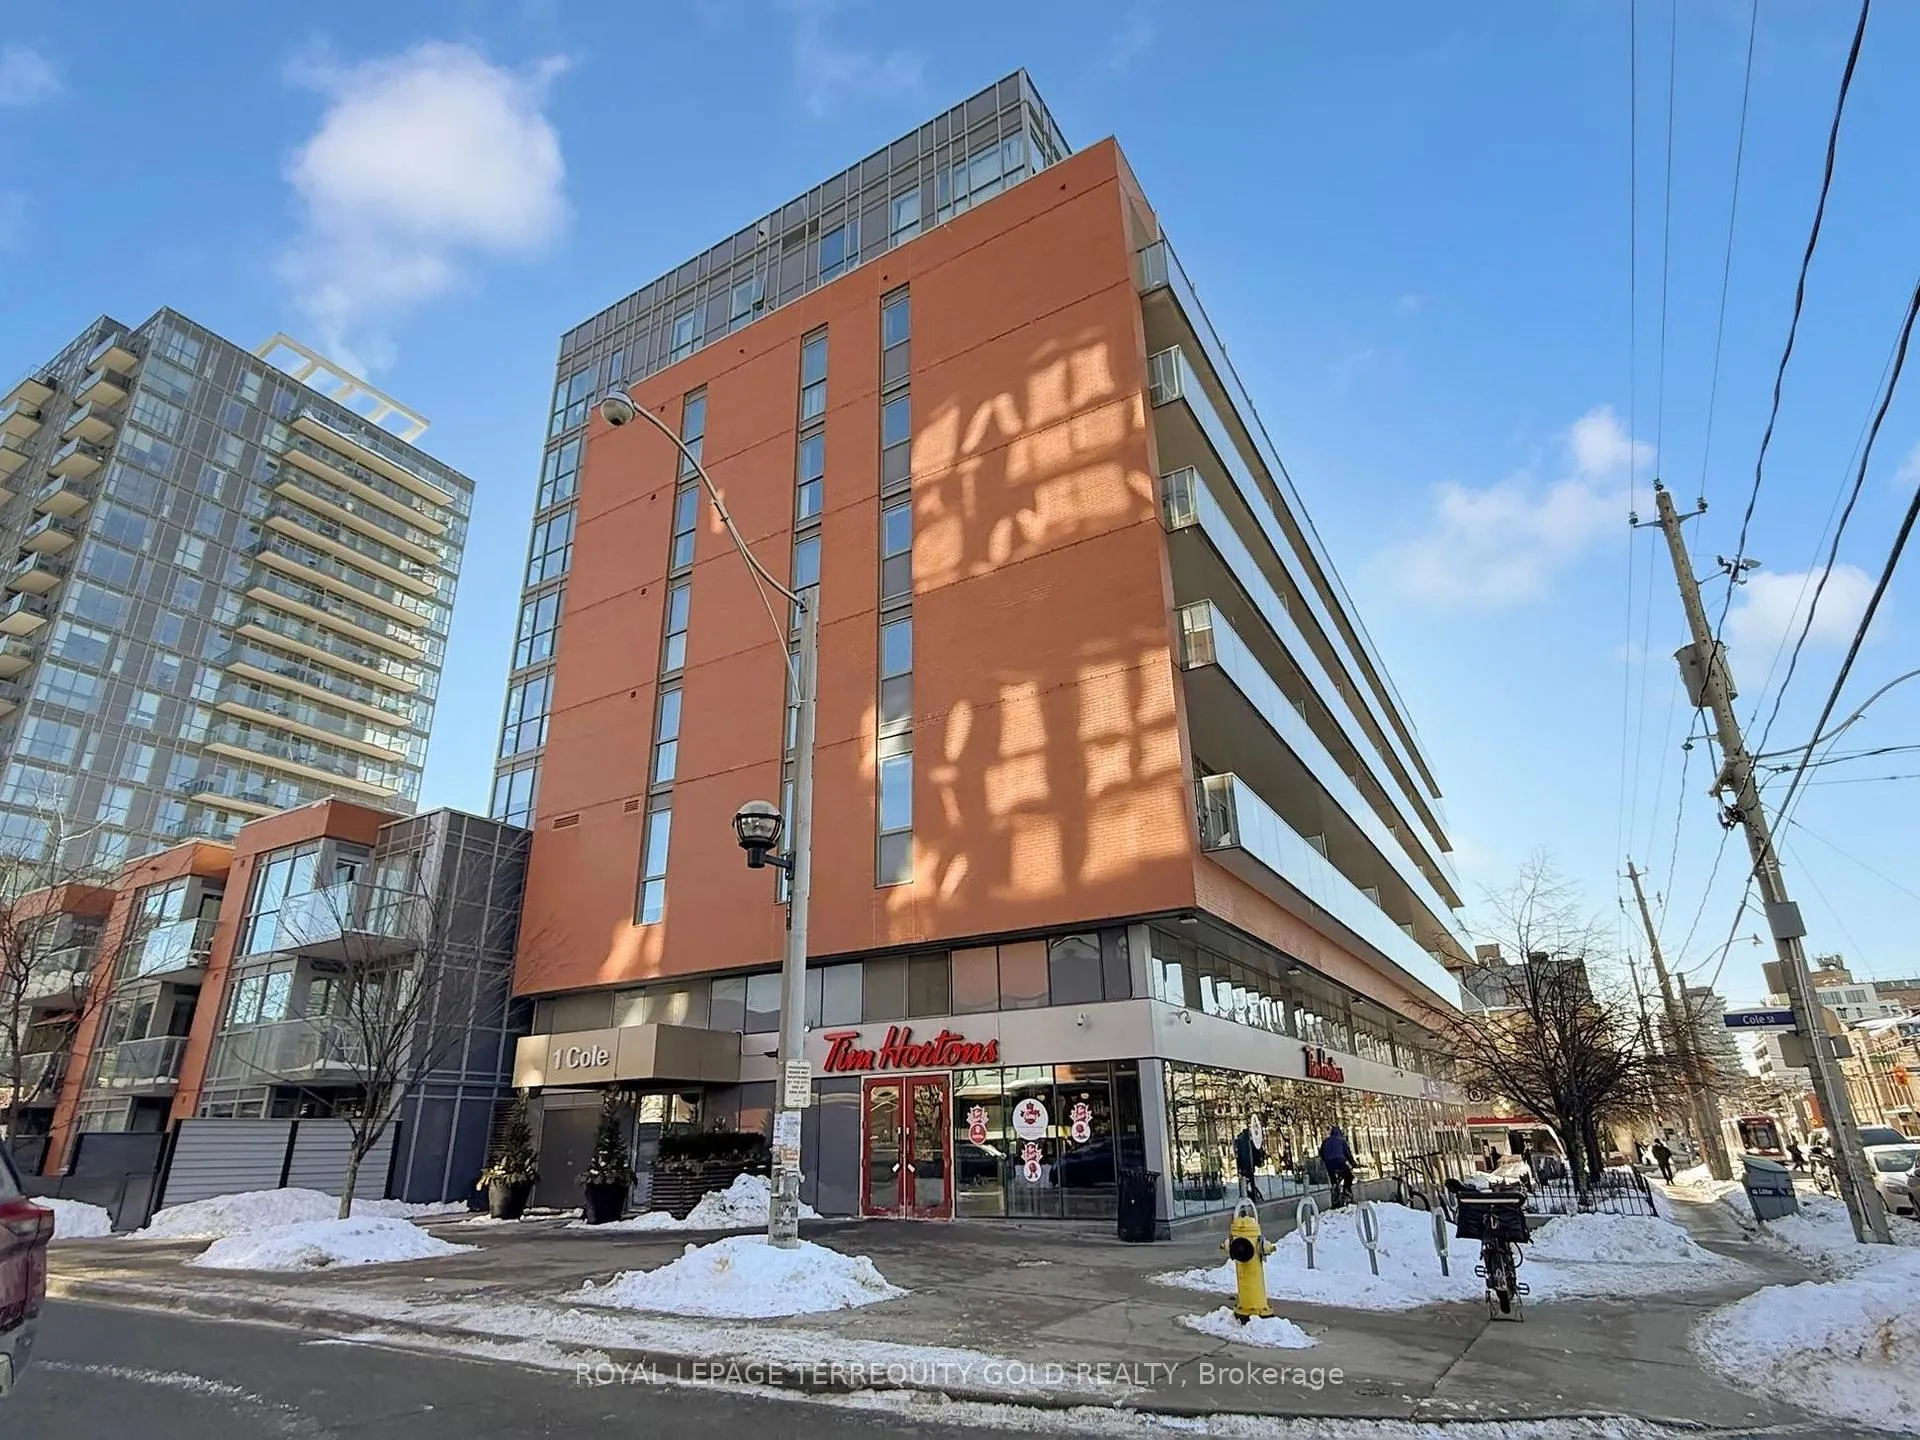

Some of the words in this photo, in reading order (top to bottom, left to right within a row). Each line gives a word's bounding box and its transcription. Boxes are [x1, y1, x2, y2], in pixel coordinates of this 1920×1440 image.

[1742, 1014, 1765, 1025] Cole
[553, 1048, 563, 1070] 1
[566, 1045, 610, 1069] Cole
[824, 1030, 876, 1073] Tim
[877, 1025, 998, 1070] Hortons
